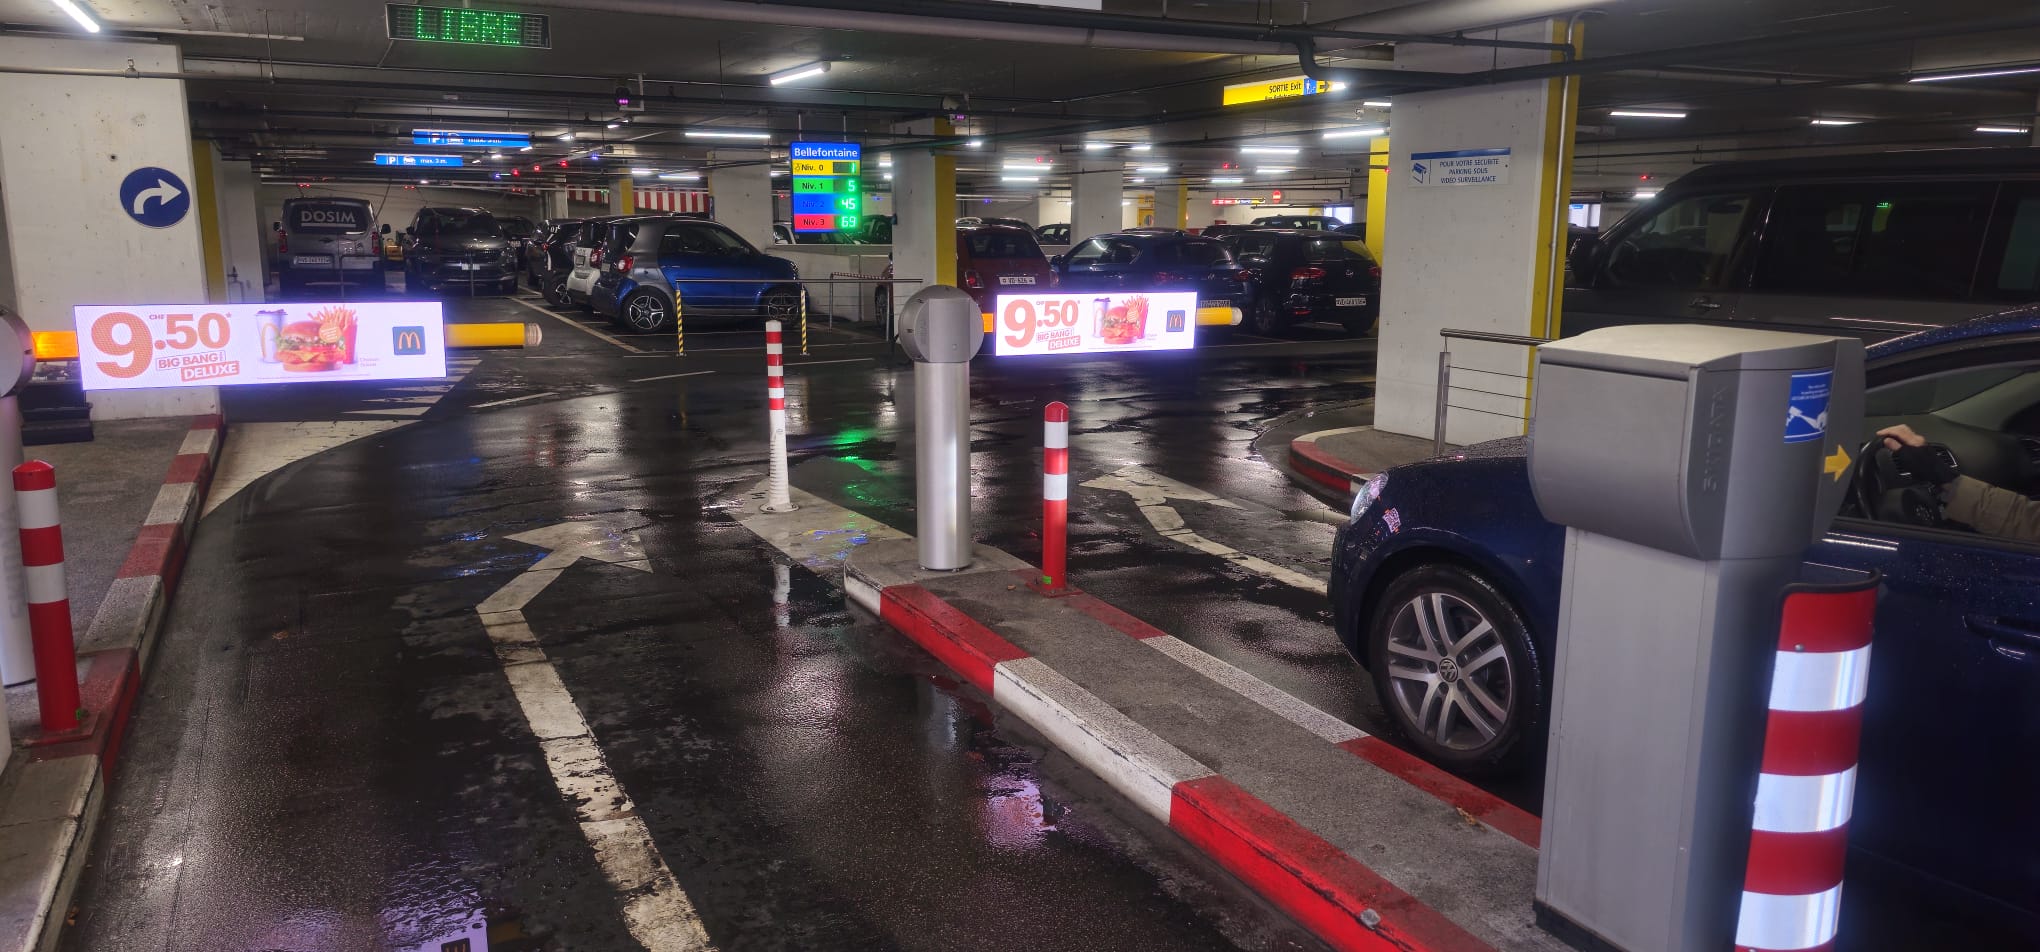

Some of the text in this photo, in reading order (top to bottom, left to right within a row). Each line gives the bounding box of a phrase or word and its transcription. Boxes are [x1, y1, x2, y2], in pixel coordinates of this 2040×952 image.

[416, 8, 521, 45] LIBRE
[1269, 82, 1302, 93] SORTIE Exit
[794, 147, 858, 158] Bellefontaine
[851, 162, 857, 173] 1
[1456, 159, 1473, 167] VOTRE
[1457, 175, 1497, 183] SURVEILLANCE
[802, 180, 856, 192] Niv. 1 5
[841, 198, 856, 210] 45
[301, 210, 356, 223] DOSIM
[841, 215, 856, 228] 69
[1037, 329, 1071, 342] BIG BANG
[1049, 336, 1080, 349] DELUXE
[158, 357, 180, 369] BIG
[182, 352, 219, 366] BANG
[184, 363, 238, 380] DELUXE
